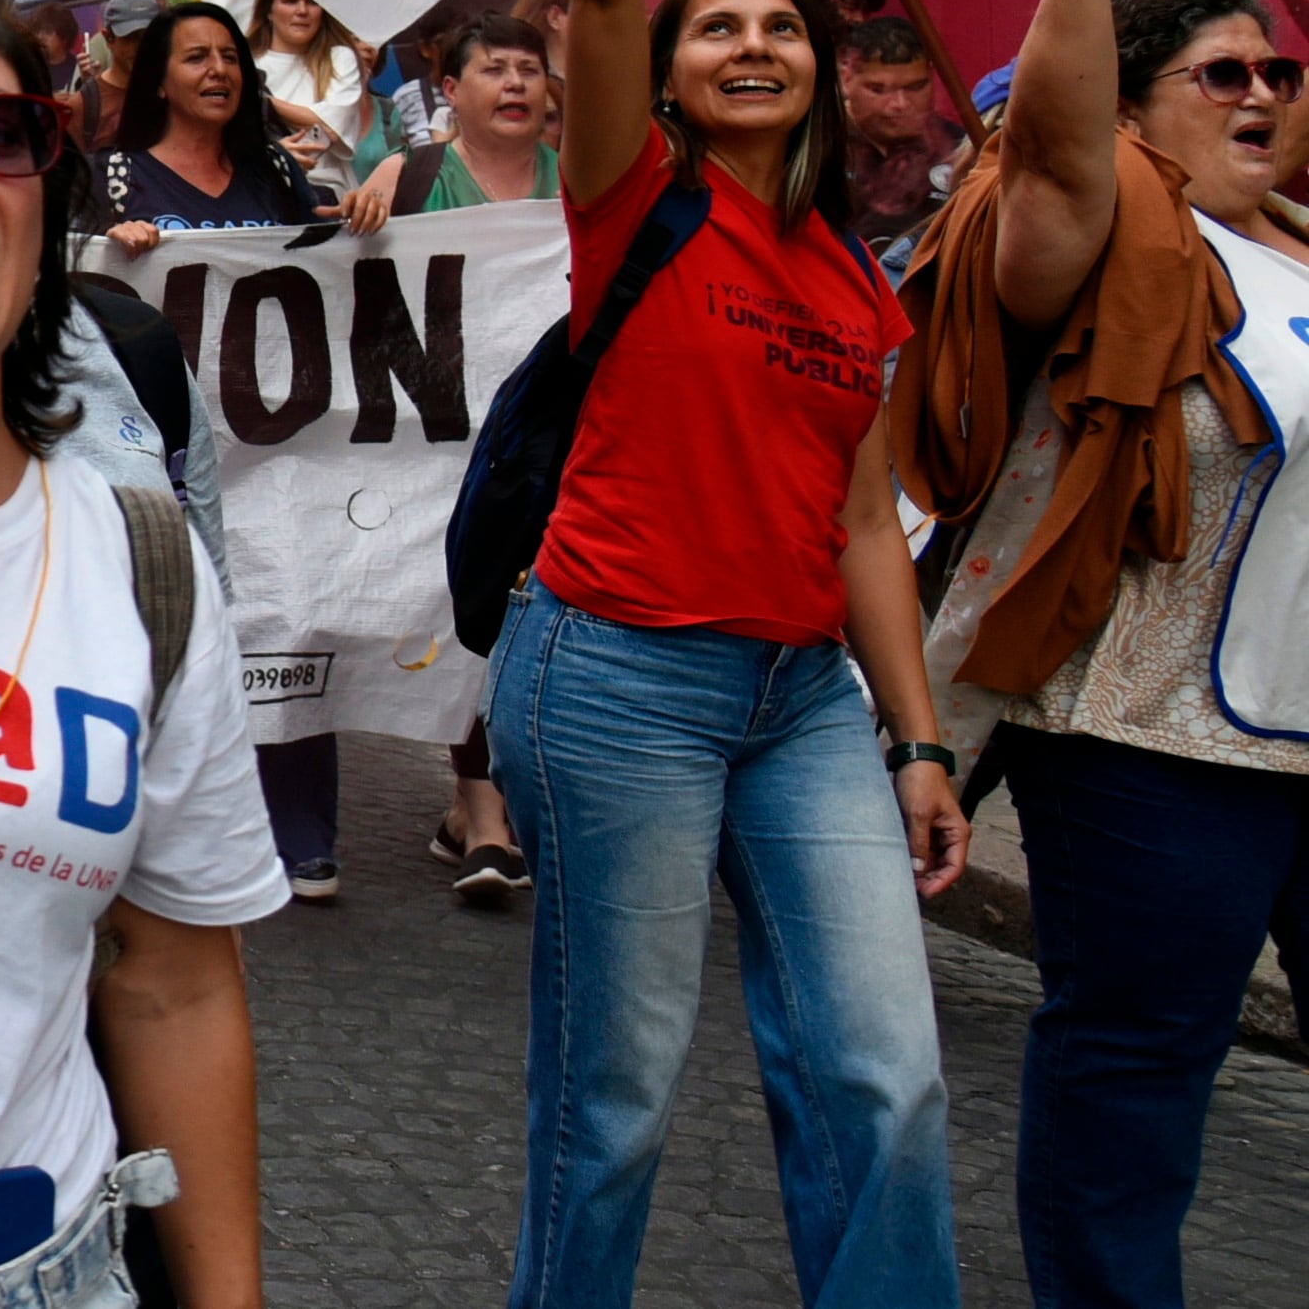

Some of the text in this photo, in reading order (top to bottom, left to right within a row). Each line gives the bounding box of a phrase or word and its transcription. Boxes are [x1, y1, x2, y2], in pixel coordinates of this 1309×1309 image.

[162, 223, 471, 445] IÓN
[11, 846, 45, 872] de
[51, 853, 72, 882] la
[76, 864, 118, 891] UNR
